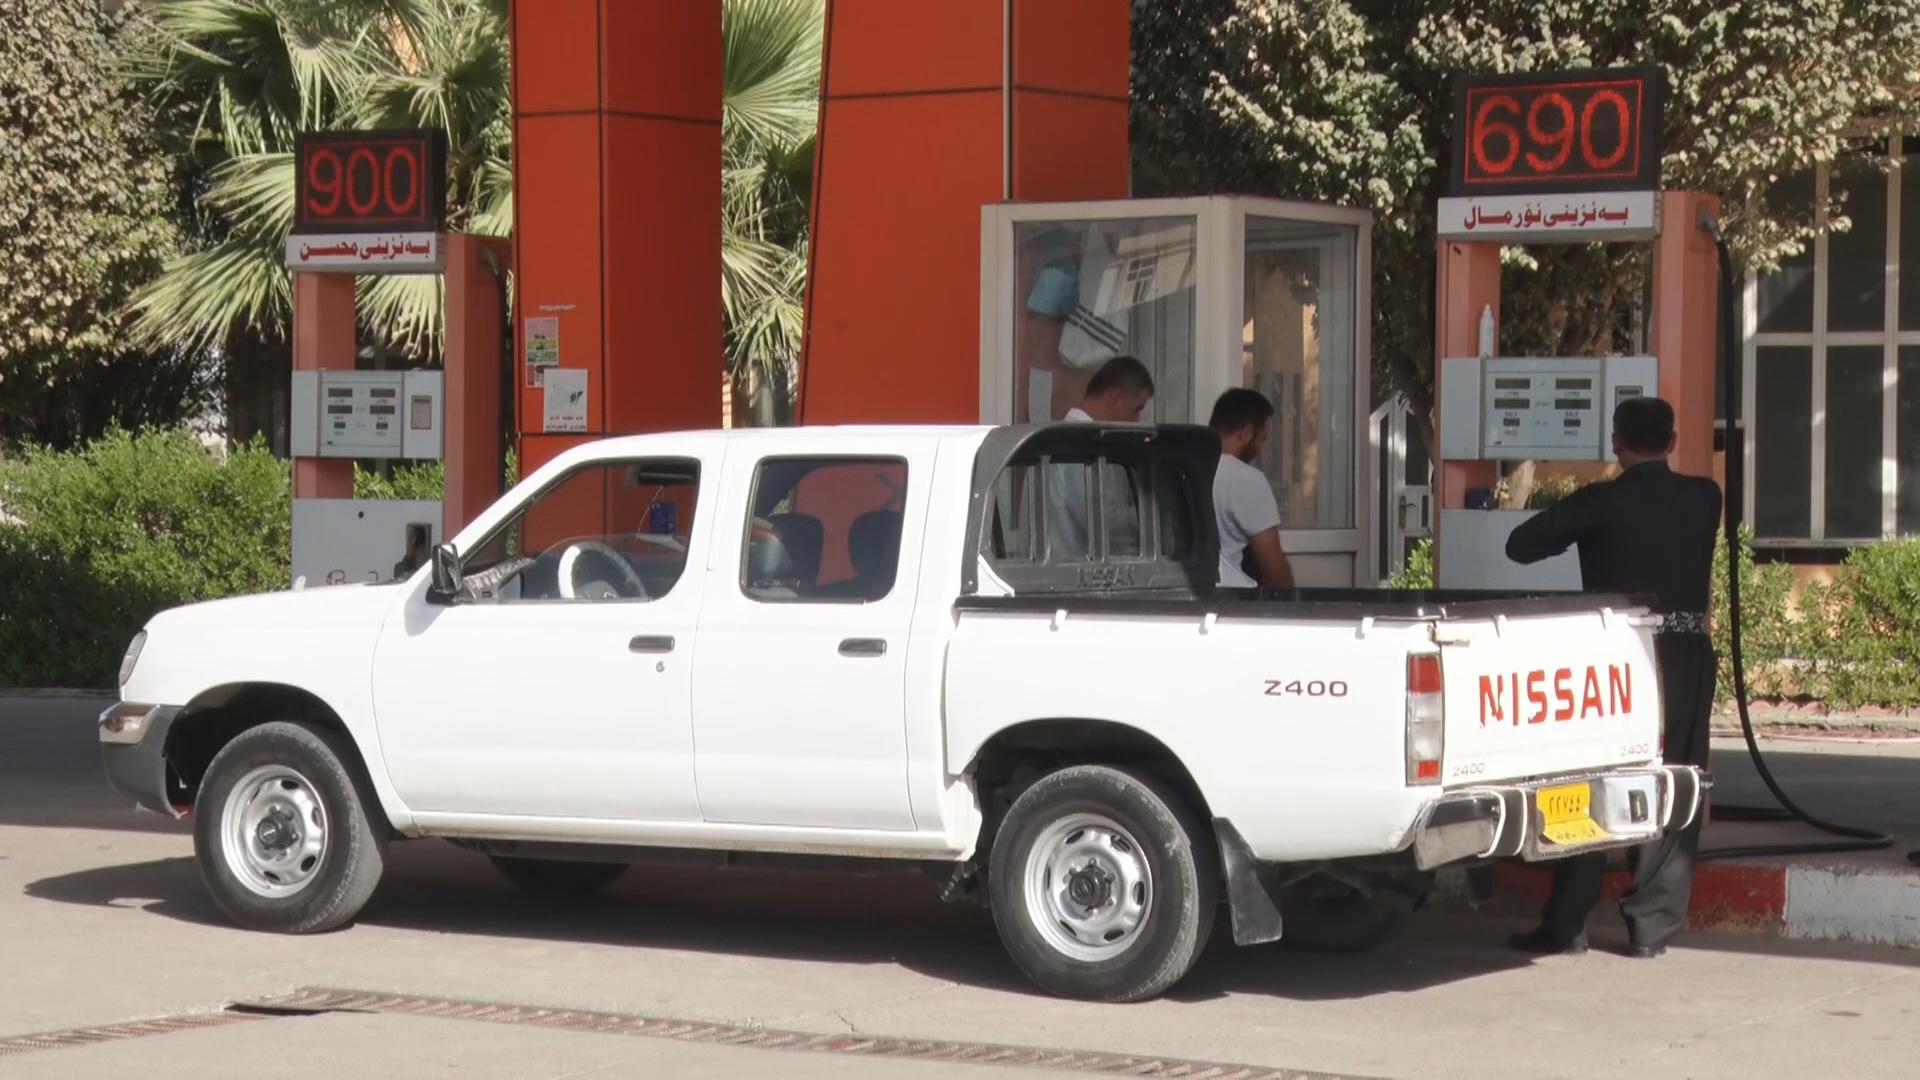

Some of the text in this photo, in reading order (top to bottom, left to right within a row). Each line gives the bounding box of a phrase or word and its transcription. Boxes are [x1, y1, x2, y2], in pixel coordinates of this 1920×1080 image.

[1472, 88, 1631, 174] 690
[308, 146, 418, 217] 900
[1479, 662, 1633, 729] NISSAN
[1452, 762, 1486, 778] 2400
